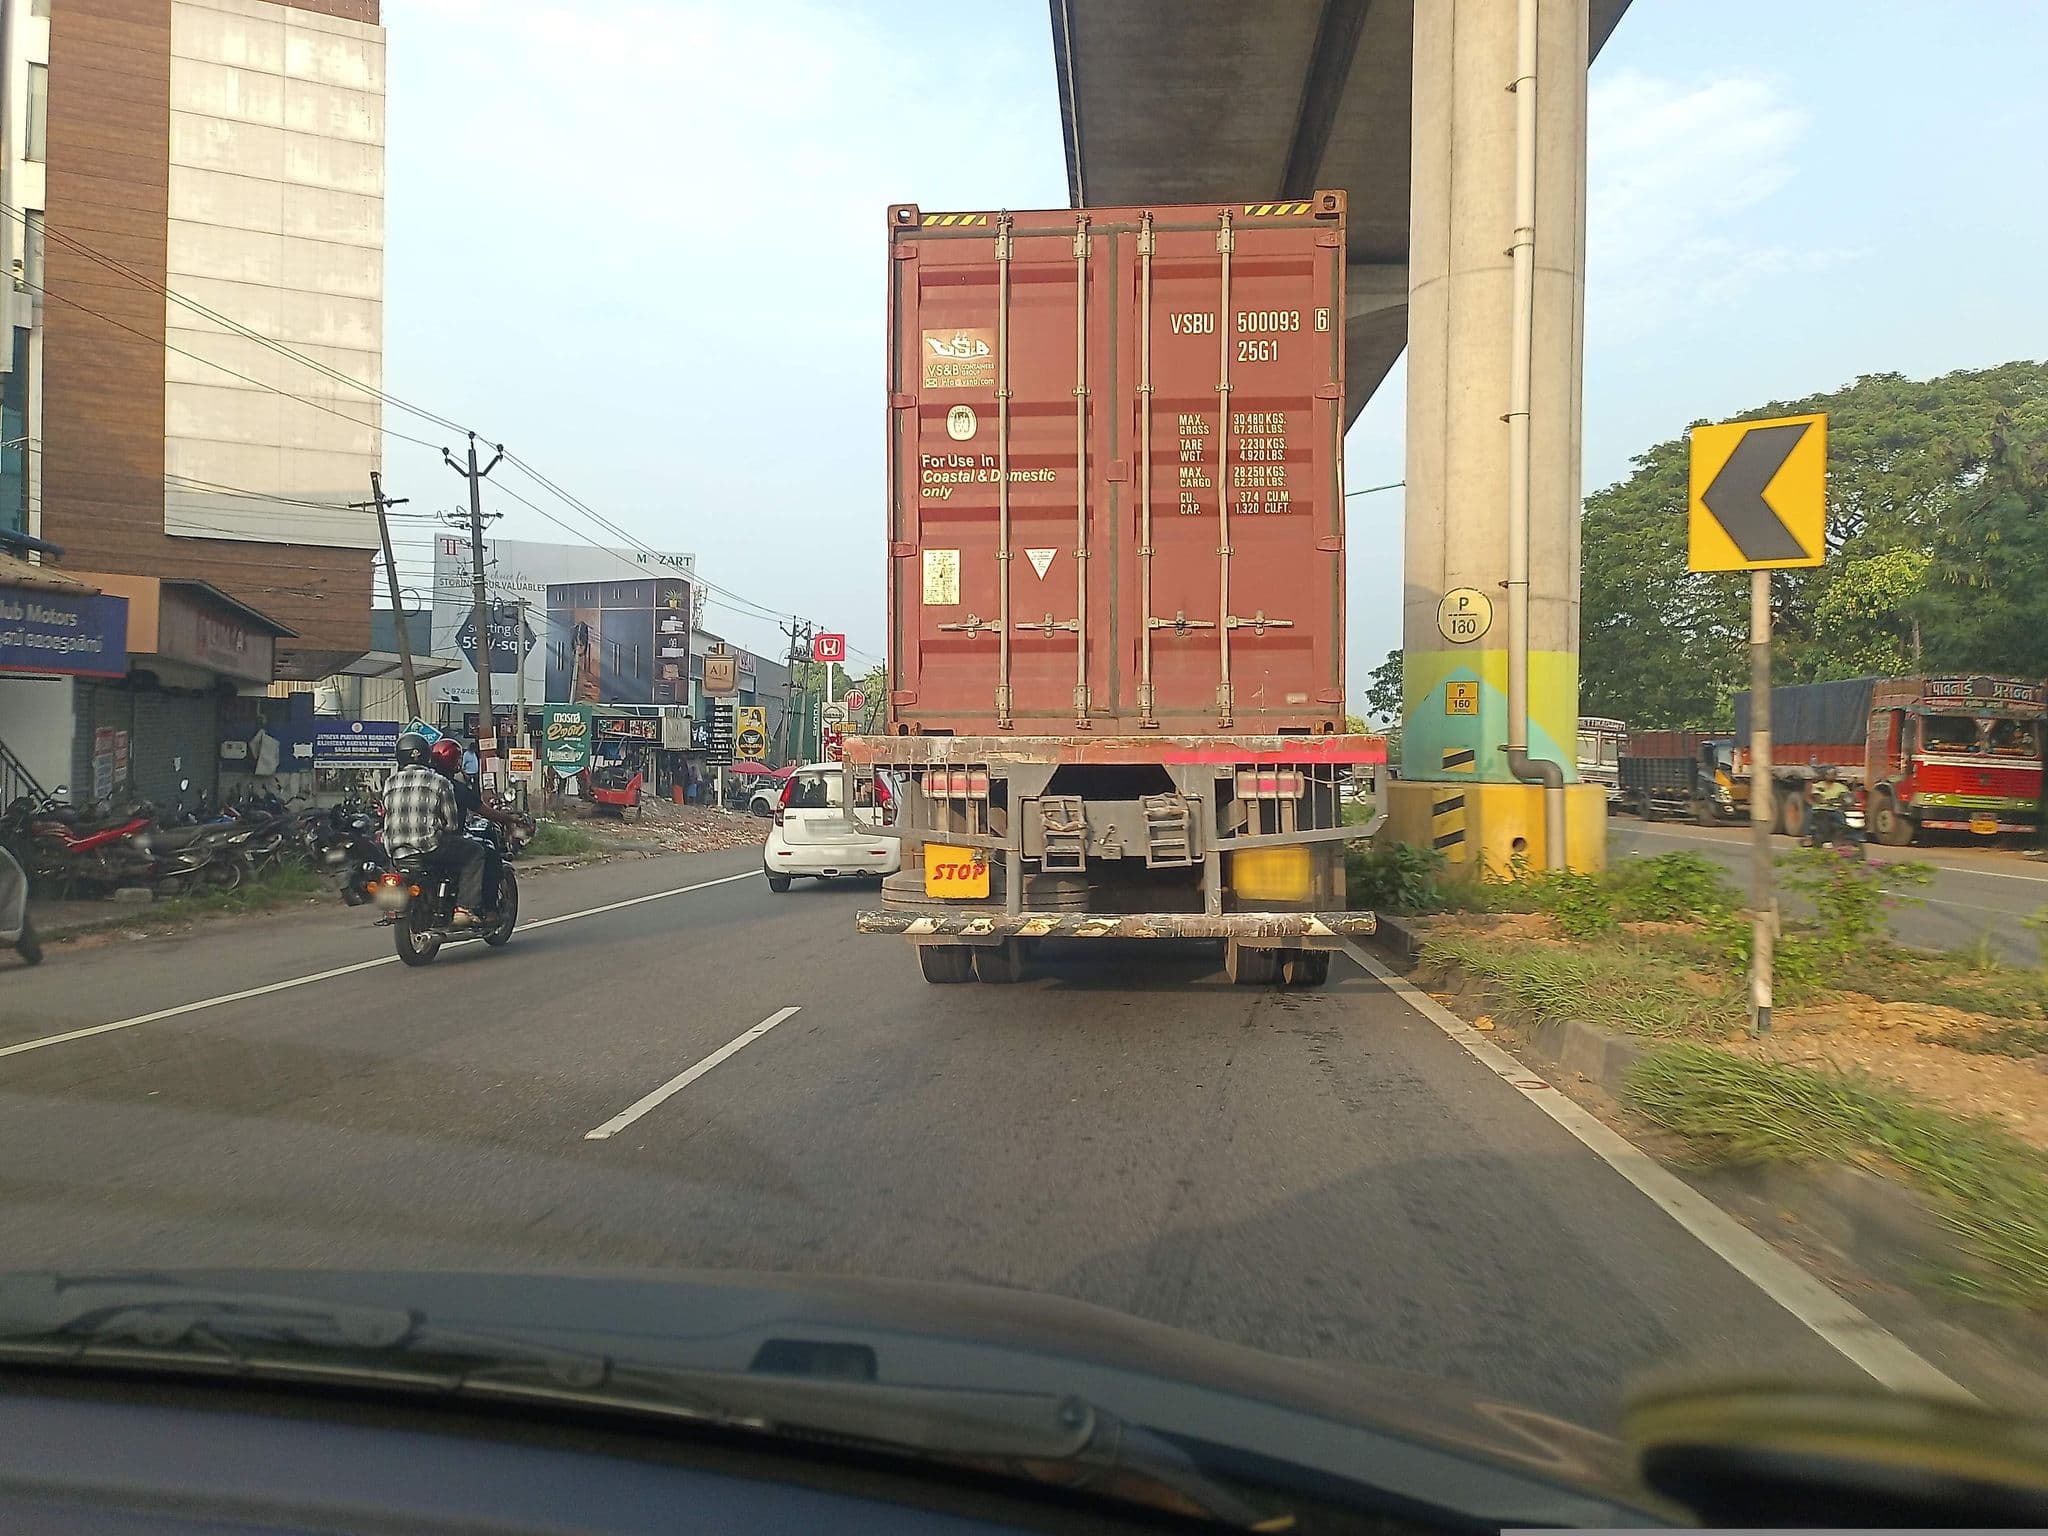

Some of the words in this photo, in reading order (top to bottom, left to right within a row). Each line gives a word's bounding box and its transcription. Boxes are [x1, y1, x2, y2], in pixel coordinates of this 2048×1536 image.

[1170, 313, 1215, 334] VSBU
[1237, 311, 1300, 333] 500093
[1316, 309, 1328, 331] 6
[1237, 340, 1278, 362] 25G1
[927, 364, 959, 376] VS&B
[1179, 414, 1205, 425] MAX.
[1233, 413, 1263, 425] 30.480
[1266, 413, 1287, 424] KGS.
[1179, 425, 1210, 435] GROSS
[1233, 425, 1263, 434] 67.200
[1266, 424, 1286, 434] LBS.
[1179, 439, 1203, 450] TARE
[1240, 438, 1264, 449] 2.230
[1266, 438, 1288, 449] KGS.
[921, 454, 945, 468] For
[948, 453, 974, 467] Use
[981, 453, 994, 467] In
[1180, 450, 1204, 462] WGT.
[1240, 450, 1264, 461] 4.920
[1266, 450, 1286, 461] LBS.
[922, 469, 975, 483] Coastal
[978, 469, 987, 482] &
[990, 468, 1056, 482] Dmestic
[1179, 467, 1205, 478] MAX.
[1234, 466, 1264, 477] 28.250
[1266, 466, 1287, 477] KGS.
[1179, 478, 1212, 488] CARGO
[1234, 478, 1264, 487] 62.280
[1266, 478, 1287, 487] LBS.
[921, 485, 953, 500] only
[1180, 492, 1195, 503] CU.
[1240, 491, 1260, 502] 37.4
[1180, 503, 1201, 515] CAP.
[1235, 503, 1259, 514] 1.320
[502, 581, 546, 591] VALUABLES
[1459, 597, 1469, 611] P
[26, 603, 78, 627] Motors
[1452, 619, 1476, 634] 160
[1458, 689, 1465, 697] P
[846, 692, 863, 708] MG
[1454, 699, 1471, 708] 160
[933, 863, 986, 880] STOP
